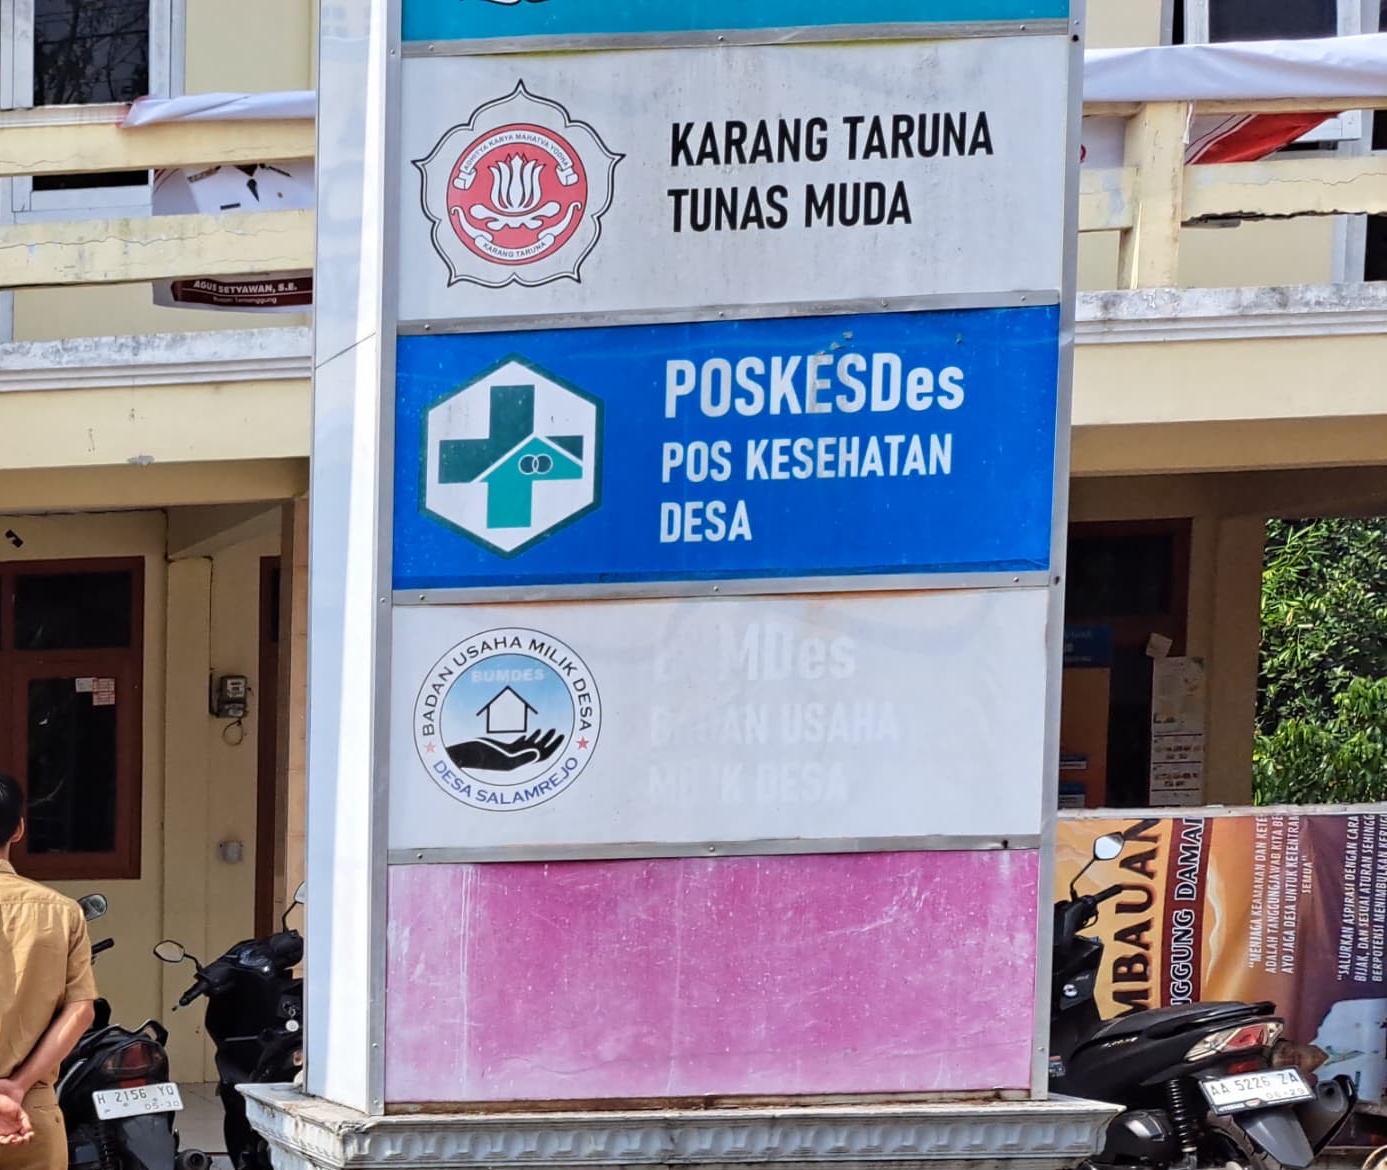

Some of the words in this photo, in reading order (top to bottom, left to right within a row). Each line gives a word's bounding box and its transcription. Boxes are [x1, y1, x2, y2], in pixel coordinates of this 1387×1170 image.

[488, 135, 514, 147] KARYA
[670, 116, 829, 167] KARANG
[842, 111, 994, 160] TARUNA
[667, 186, 789, 233] TUNAS
[804, 181, 913, 229] MUDA
[482, 242, 514, 258] KARANG
[515, 241, 547, 257] TARUNA
[193, 280, 217, 292] AGUS
[664, 352, 965, 418] POSKESDes
[661, 440, 733, 484] POS
[745, 433, 954, 482] KESEHATAN
[659, 500, 753, 543] DESA
[422, 665, 455, 737] BADAN
[452, 635, 523, 668] USAHA
[528, 638, 579, 678] MILIK
[572, 677, 594, 732] DESA
[470, 667, 546, 684] BUMDES
[432, 758, 473, 798] DESA
[474, 756, 579, 806] SALAMREJO
[1271, 830, 1283, 850] KITA
[1347, 815, 1360, 840] CARA
[1344, 843, 1358, 881] DENGAN
[1360, 856, 1373, 894] ATURAN
[1285, 869, 1298, 902] UNTUK
[1284, 904, 1297, 927] DESA
[1343, 883, 1356, 925] ASPIRASI
[1283, 930, 1296, 954] JAGA
[1357, 929, 1370, 950] DAN
[1265, 937, 1278, 974] ADALAH
[1281, 955, 1294, 974] AYO
[96, 1093, 107, 1105] H
[114, 1087, 148, 1103] 2156
[1210, 1083, 1231, 1097] AA
[1234, 1076, 1272, 1092] 5226
[1277, 1071, 1300, 1086] ZA
